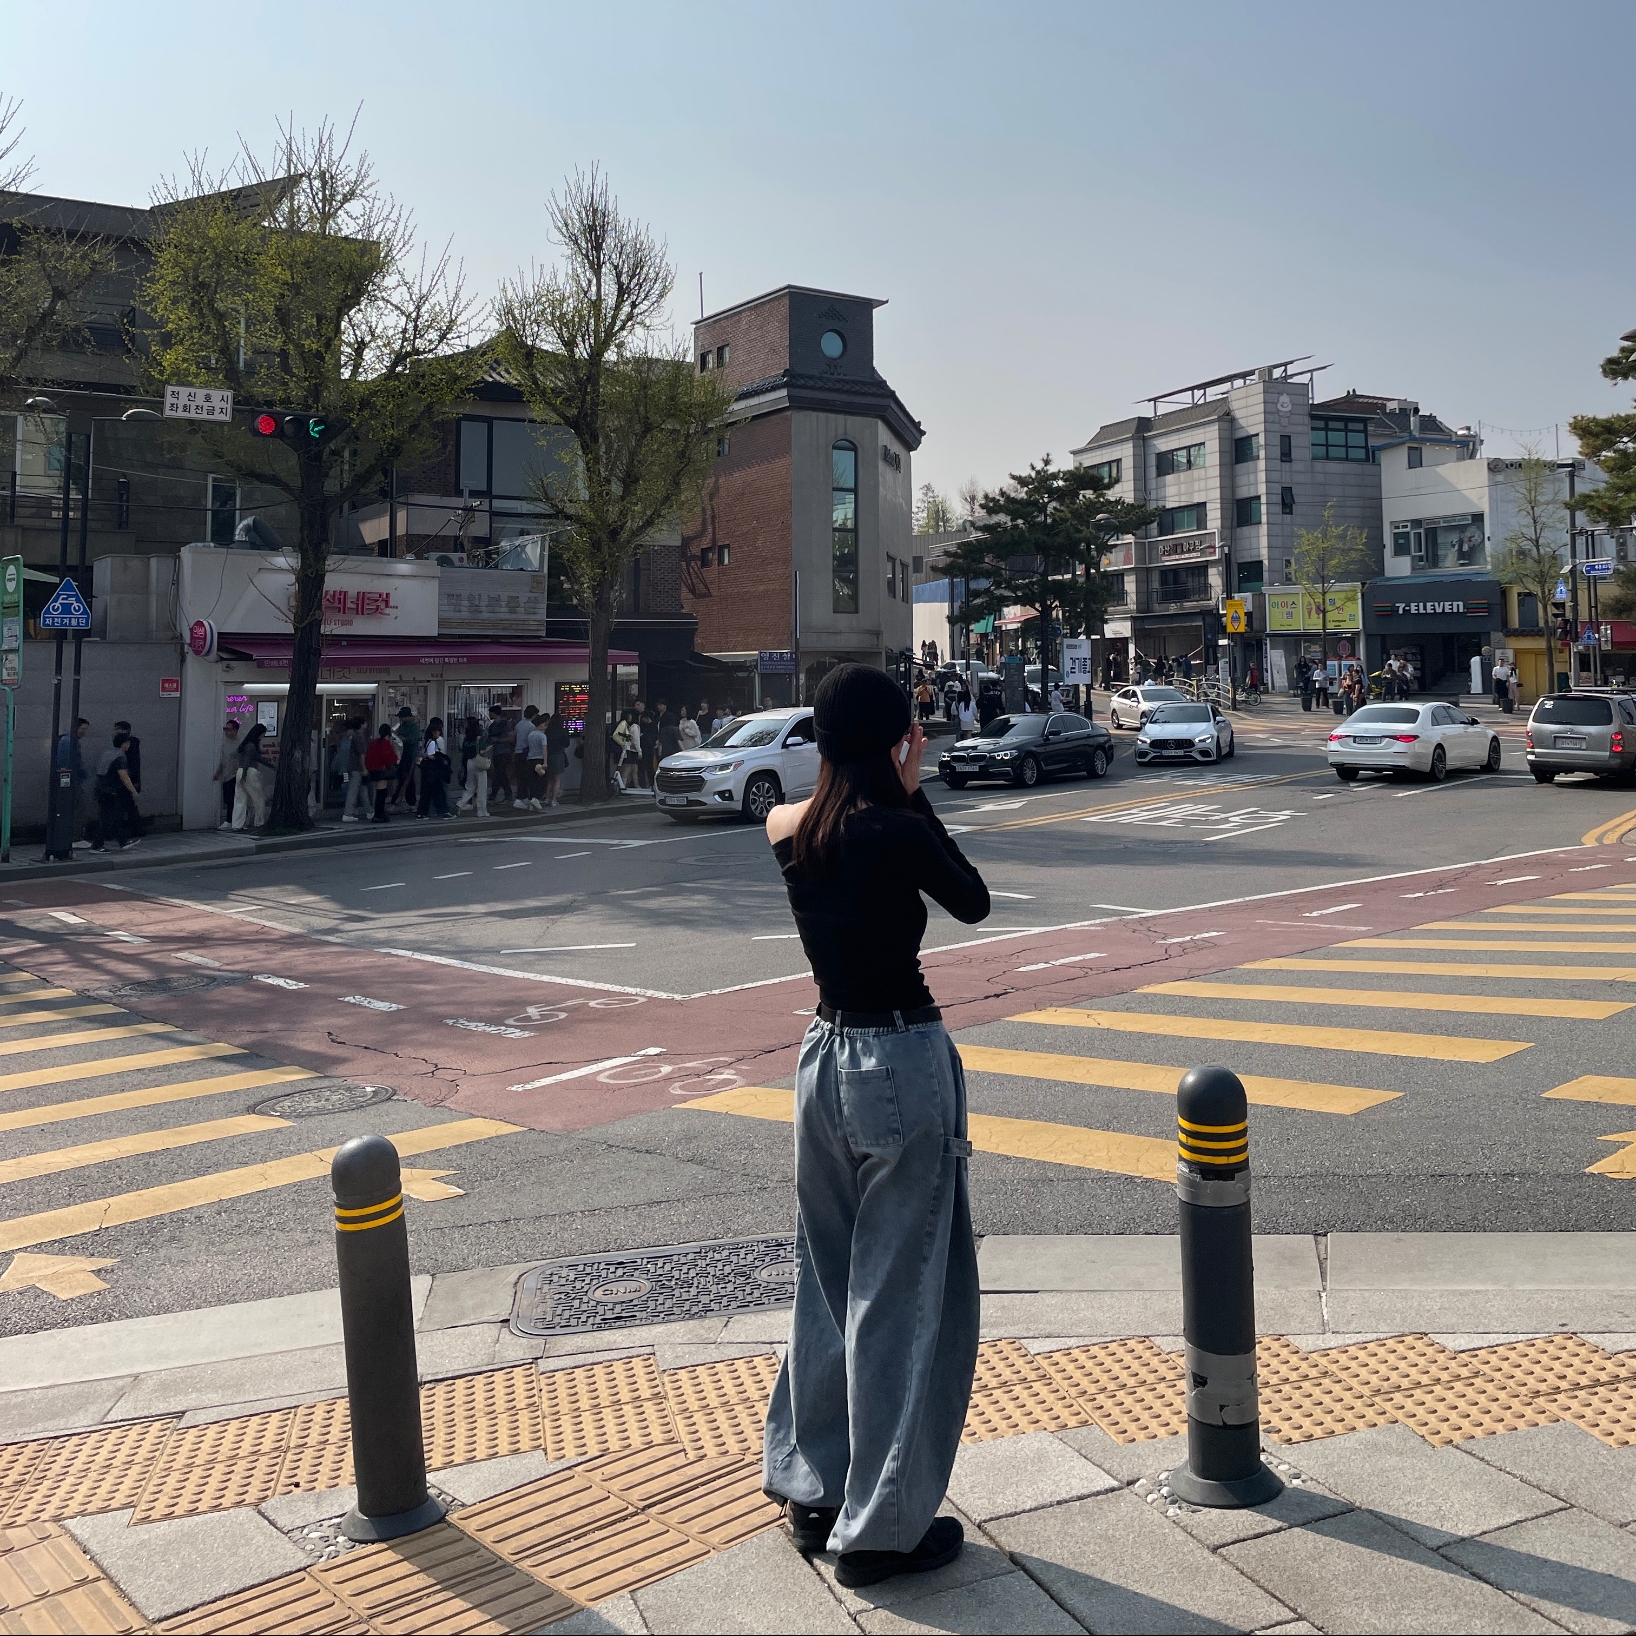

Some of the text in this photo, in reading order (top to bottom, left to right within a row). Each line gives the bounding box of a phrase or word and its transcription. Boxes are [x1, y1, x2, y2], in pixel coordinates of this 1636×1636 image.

[168, 402, 228, 417] 좌회전금지
[1271, 600, 1297, 609] 아이스
[44, 617, 87, 628] 자전거횡단
